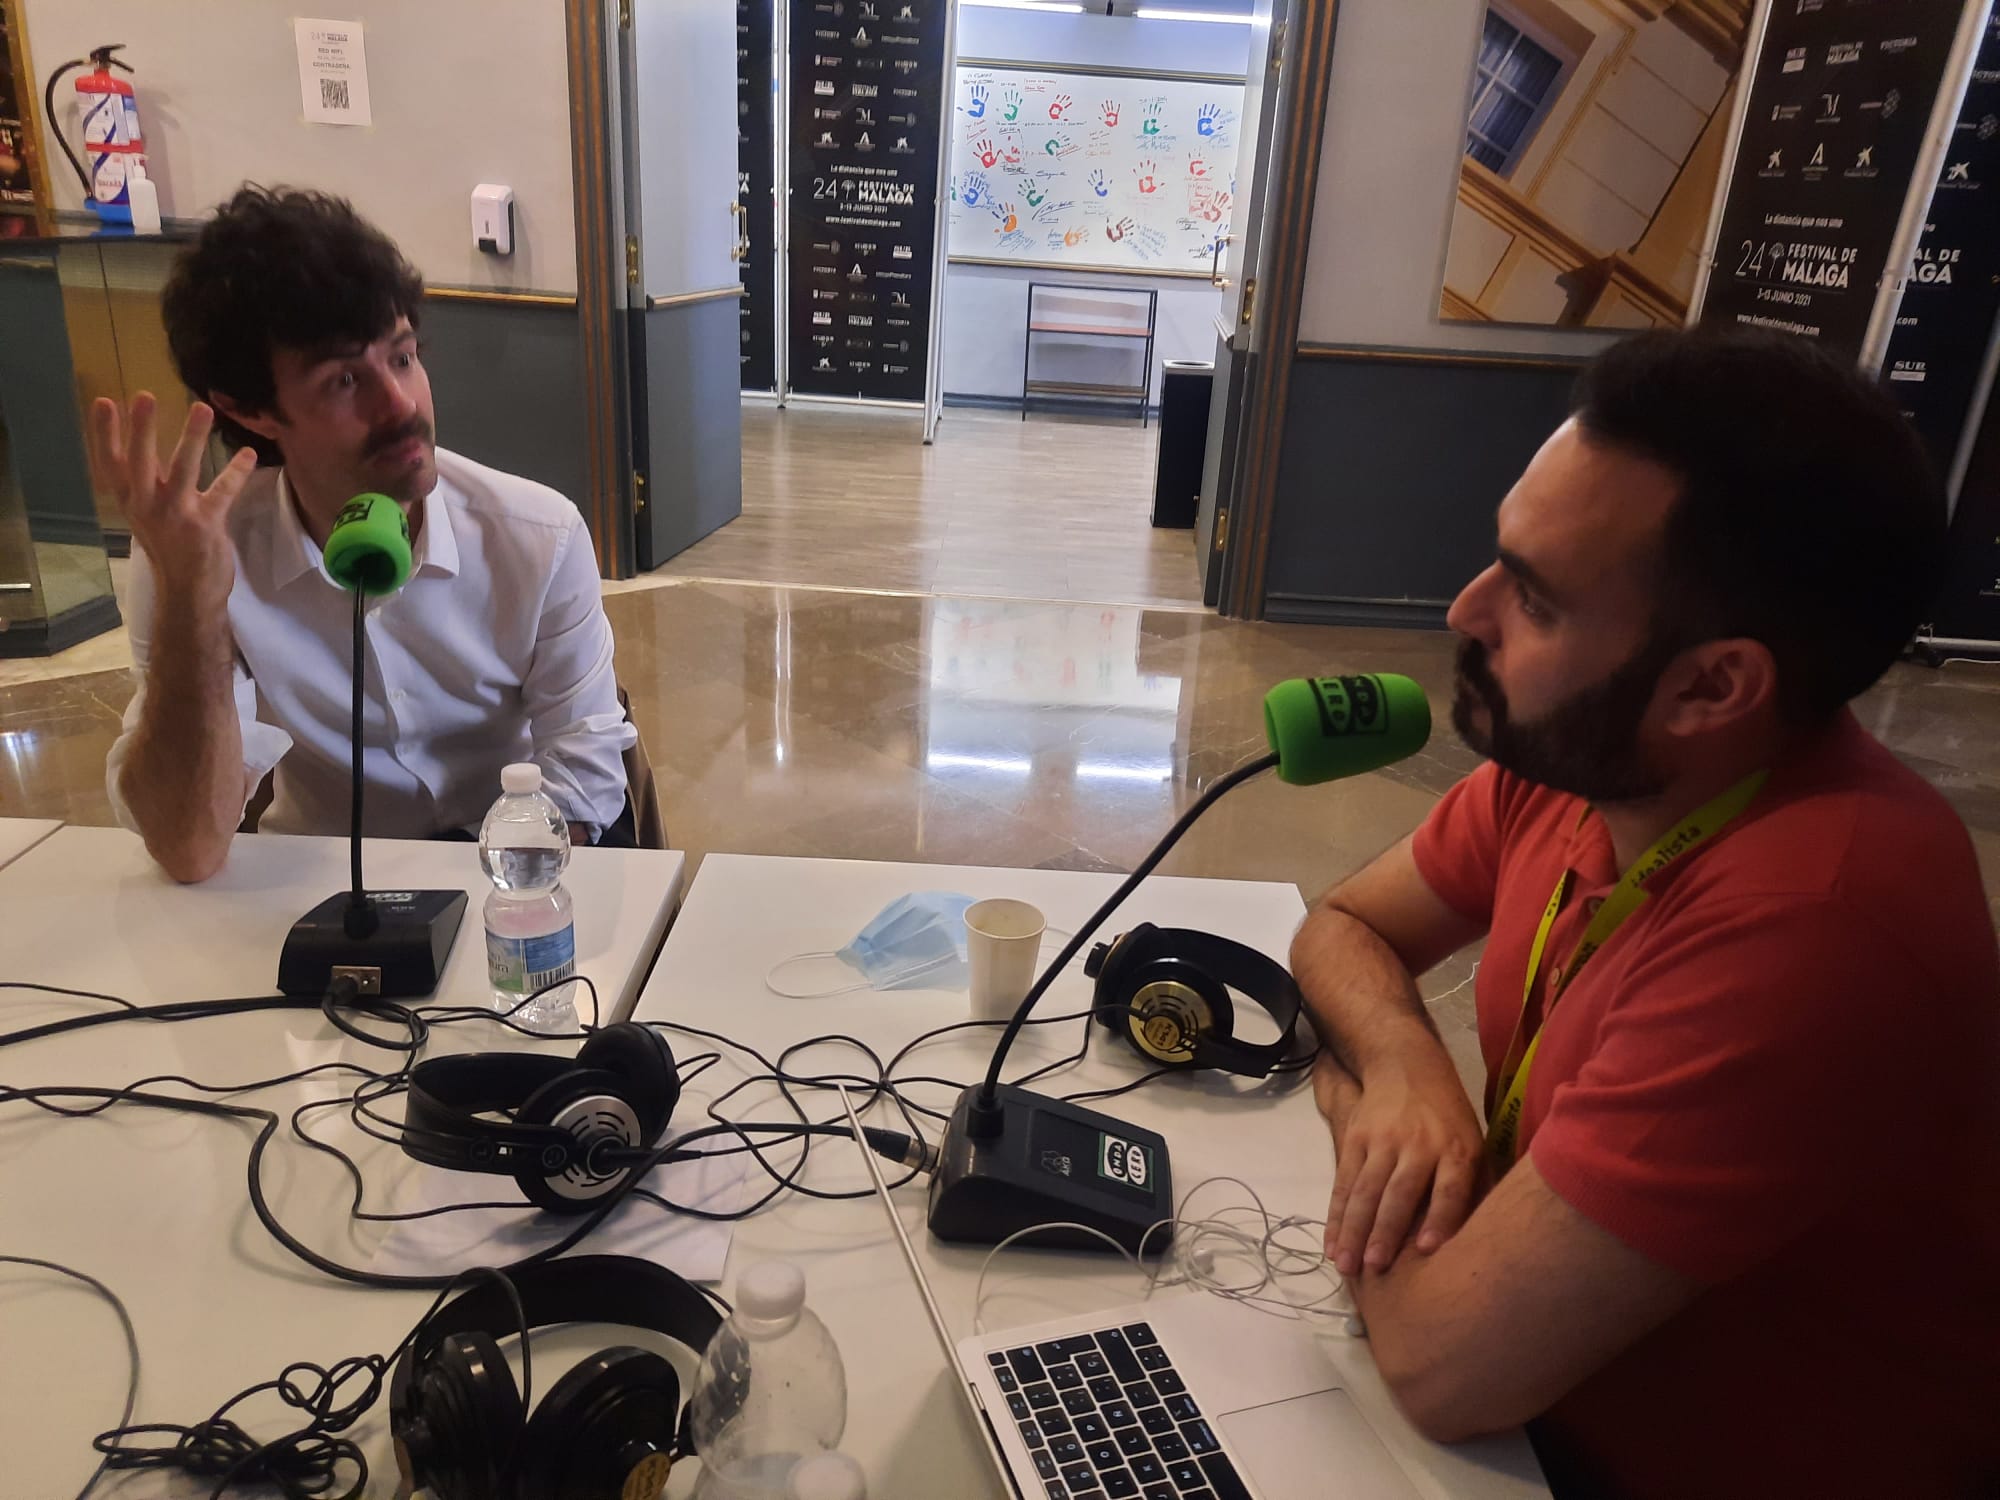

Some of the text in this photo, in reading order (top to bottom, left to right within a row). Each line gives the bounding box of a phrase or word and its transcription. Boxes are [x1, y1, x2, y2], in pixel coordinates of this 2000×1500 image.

[813, 177, 837, 200] 24
[858, 180, 915, 194] FESTIVAL DE
[1735, 239, 1767, 280] 24
[1787, 243, 1859, 264] FESTIVAL DE
[1938, 248, 1962, 263] DE
[1907, 263, 1953, 284] AGA
[1770, 289, 1794, 303] JUNIO
[1794, 292, 1811, 307] 2021
